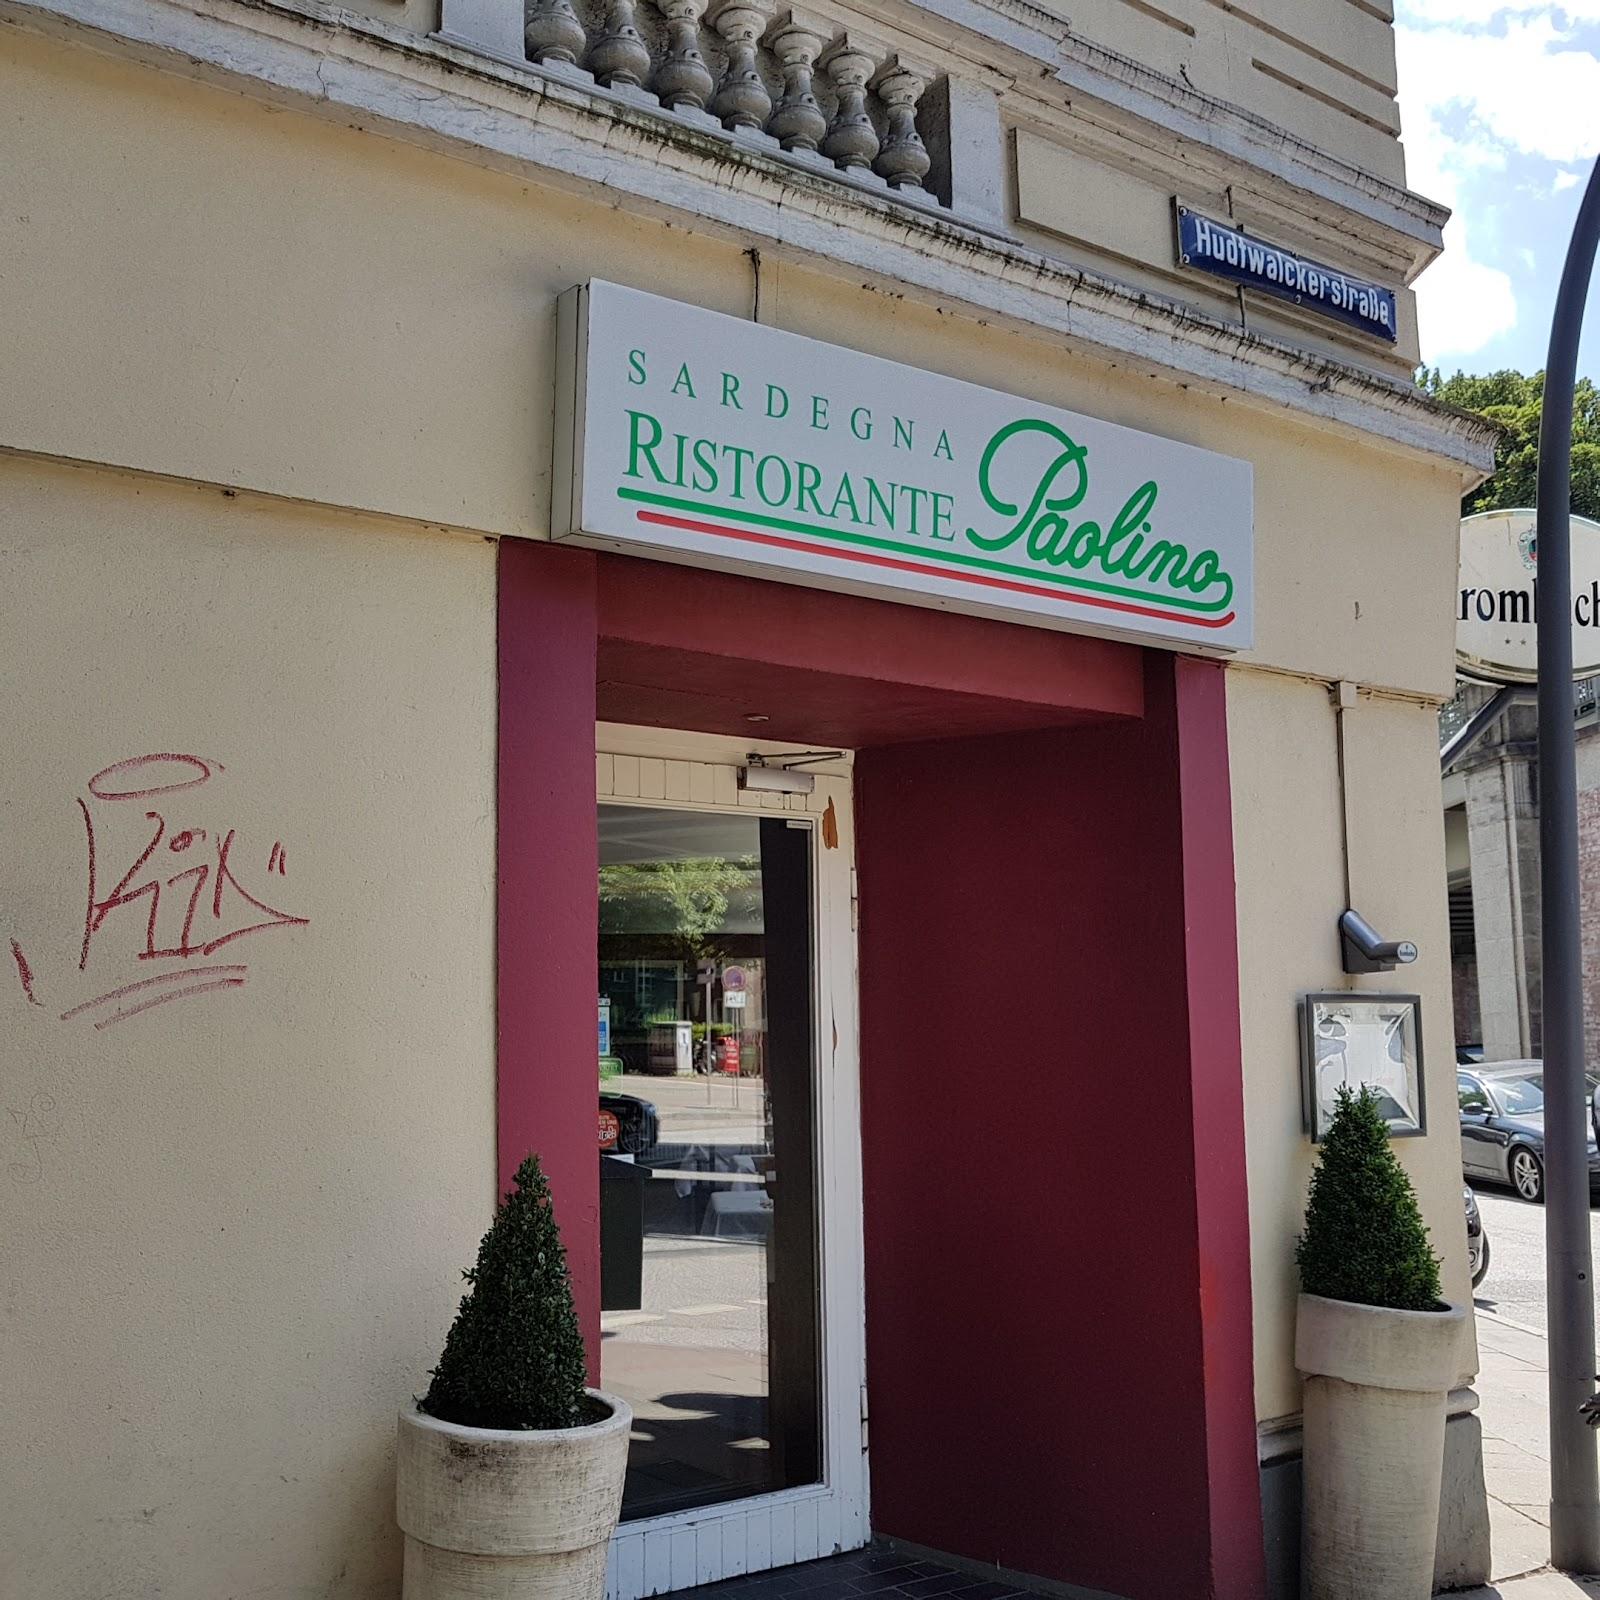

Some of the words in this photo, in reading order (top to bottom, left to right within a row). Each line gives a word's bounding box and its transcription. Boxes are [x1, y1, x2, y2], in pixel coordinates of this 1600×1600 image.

[1195, 219, 1389, 325] Hudtwalckerstraße
[627, 349, 955, 461] SARDEGNA
[622, 409, 956, 542] RISTORANTE
[966, 419, 1234, 608] Paolino
